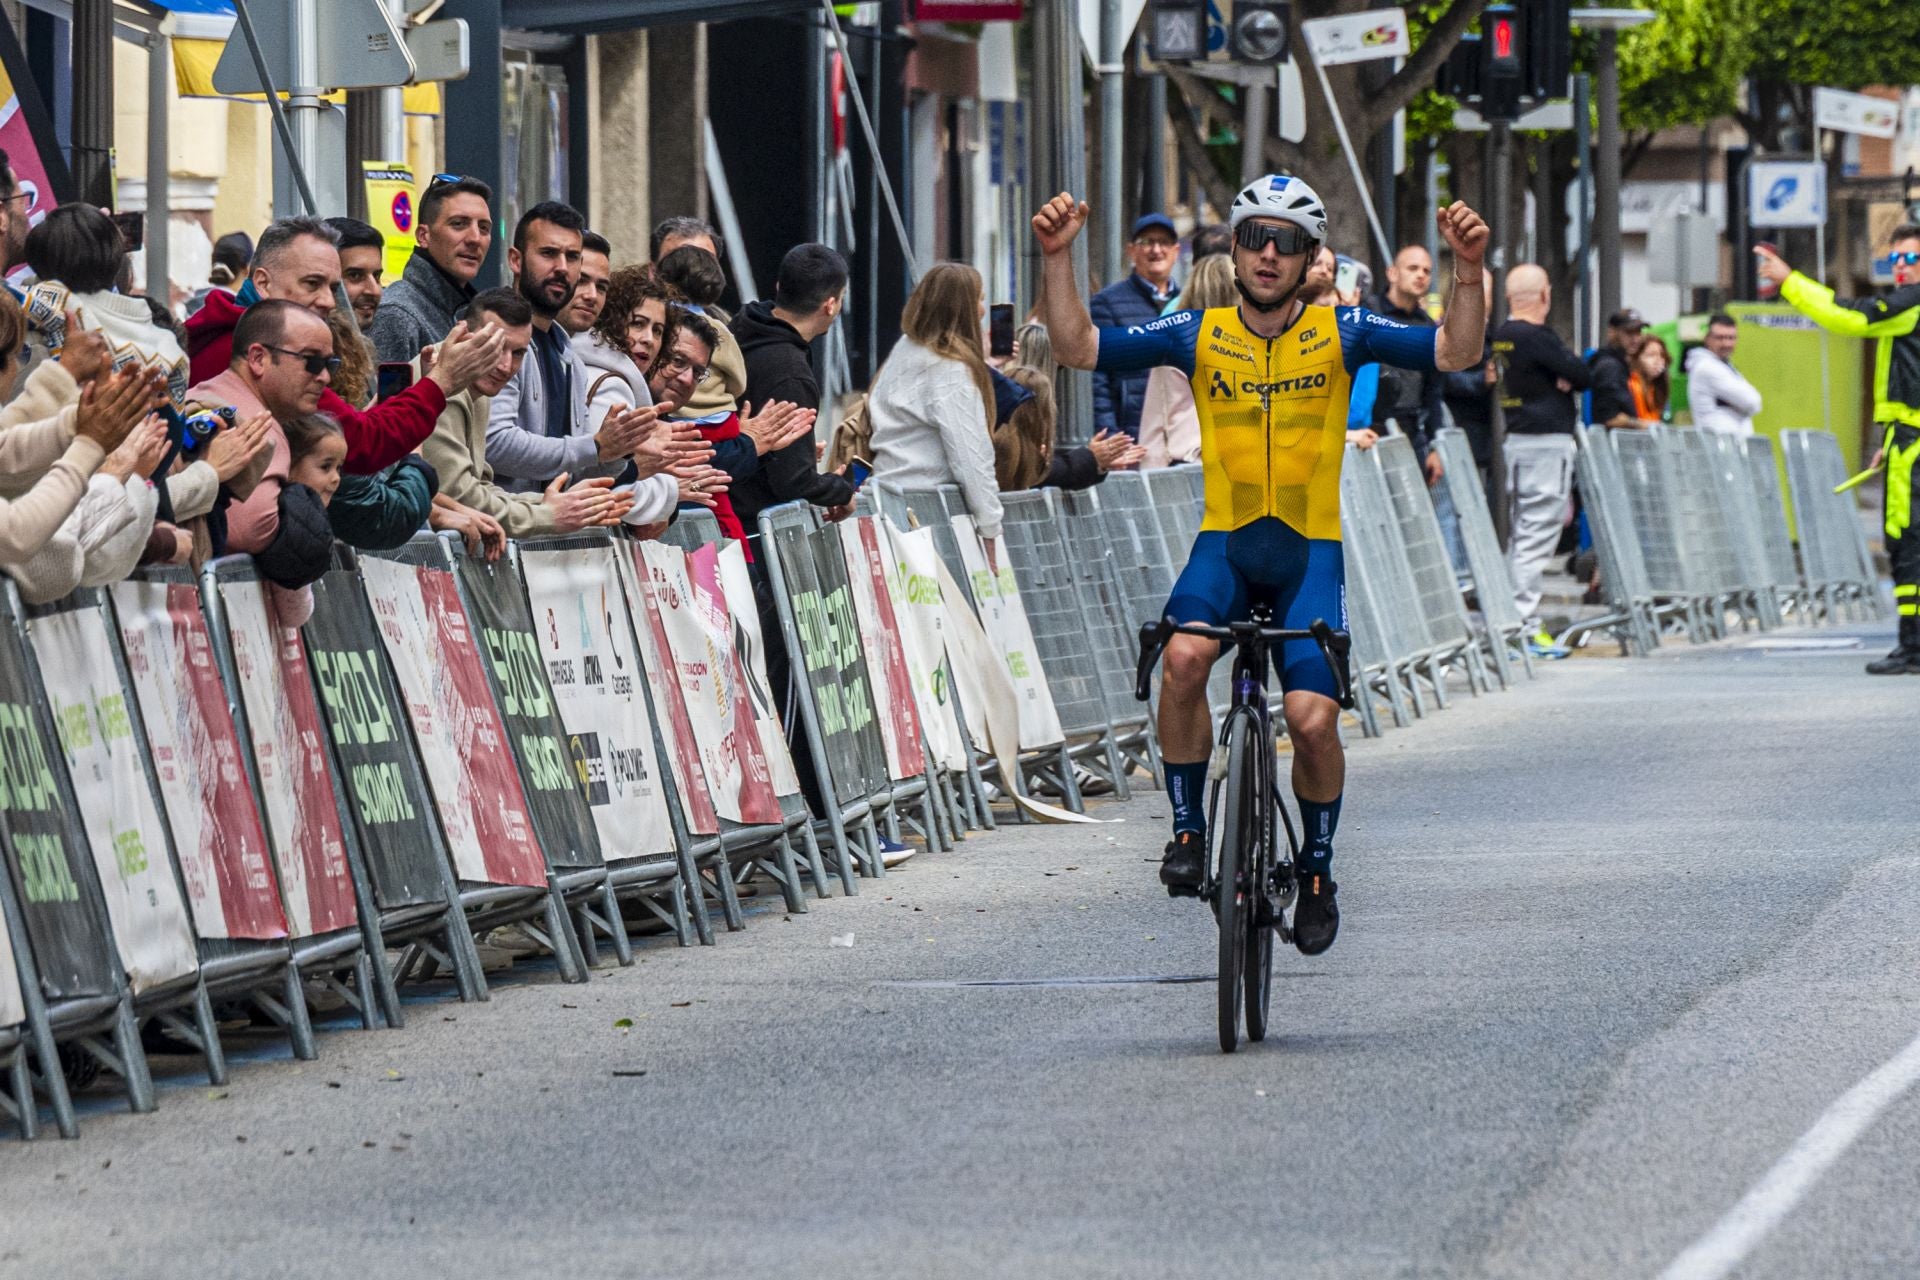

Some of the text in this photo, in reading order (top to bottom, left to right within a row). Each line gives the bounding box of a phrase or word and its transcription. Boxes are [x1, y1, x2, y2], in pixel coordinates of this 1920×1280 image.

[1145, 311, 1192, 331] CORTIZO
[1241, 372, 1327, 395] CORTIZO
[1173, 775, 1184, 805] CORTIZO
